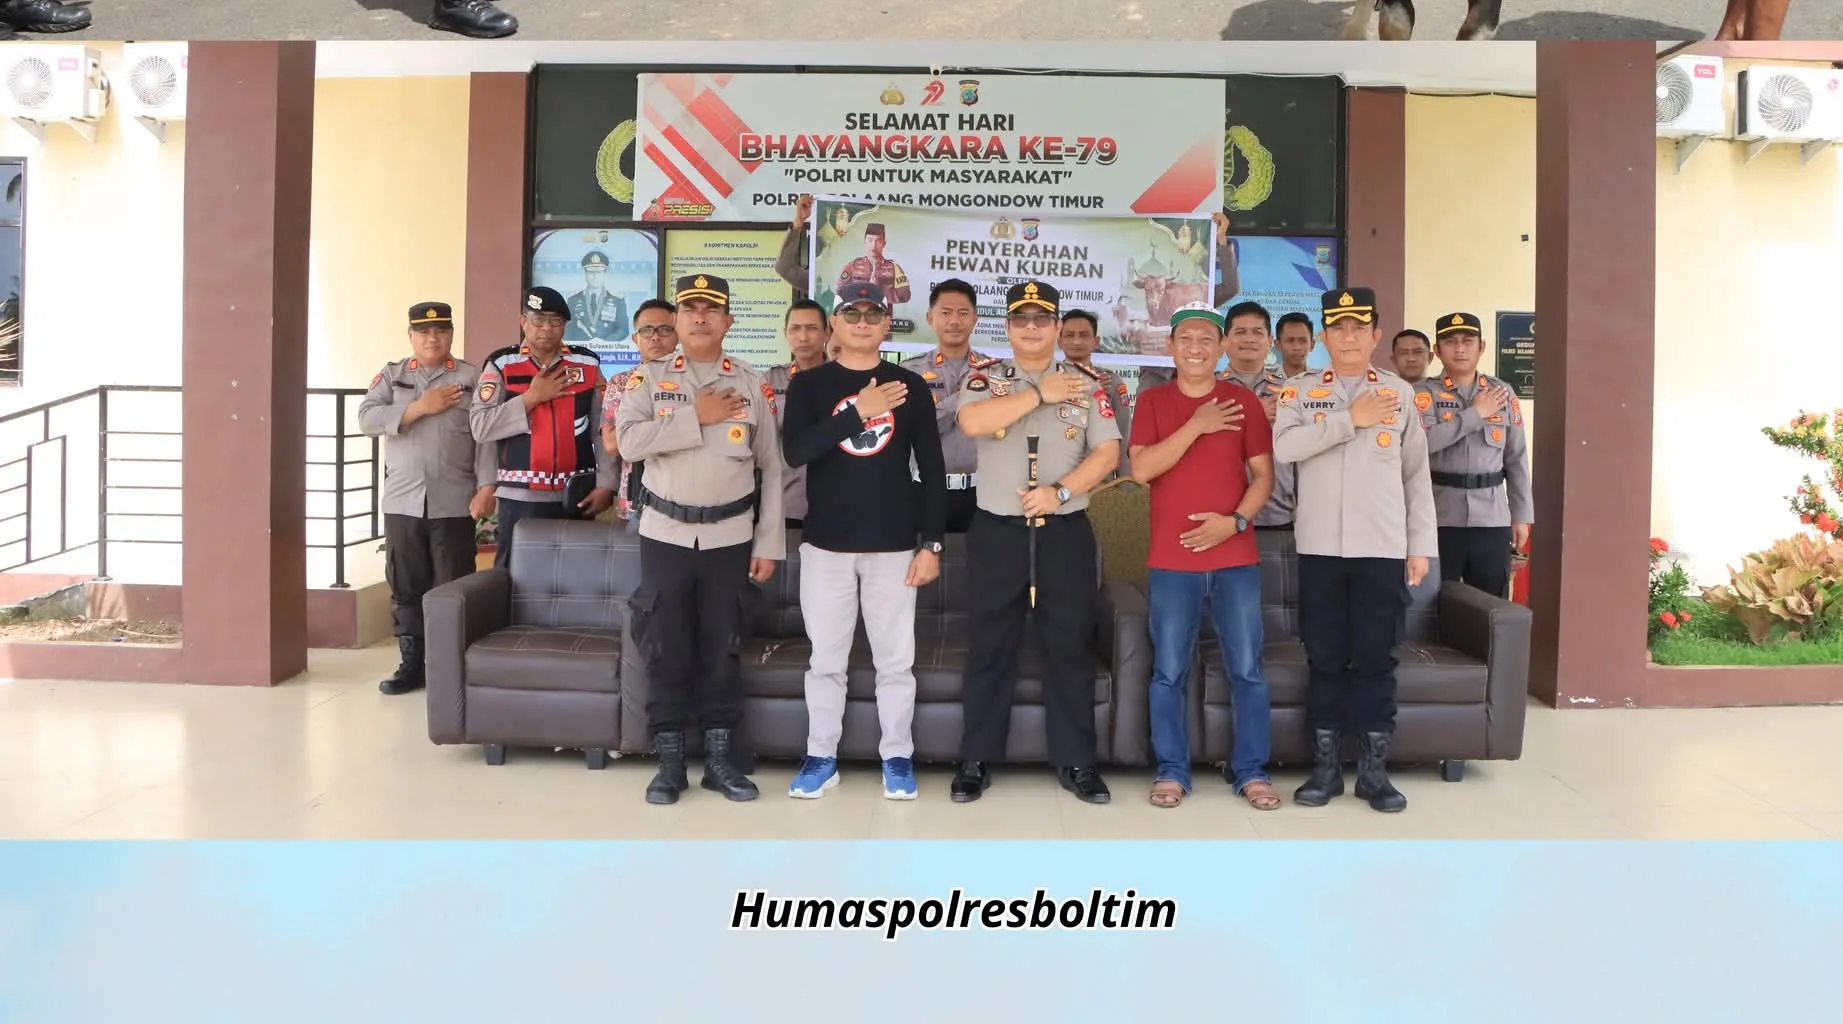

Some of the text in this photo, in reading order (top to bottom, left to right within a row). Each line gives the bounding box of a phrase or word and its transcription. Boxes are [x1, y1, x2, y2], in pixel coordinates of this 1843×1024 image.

[845, 113, 1014, 131] SELAMAT HARI
[739, 134, 1118, 164] BHAYANGKARA KE-79
[784, 168, 1073, 184] "POLRI UNTUK MASYARAKAT"
[753, 193, 806, 206] POLR
[919, 193, 1043, 208] MONGONDOW
[1049, 195, 1105, 209] TIMUR
[946, 239, 1088, 261] PENYERAHAN
[930, 255, 1104, 279] HEWAN KURBAN
[973, 284, 1008, 296] OLAANG
[1075, 290, 1104, 301] TIMUR
[654, 391, 687, 402] BERTI
